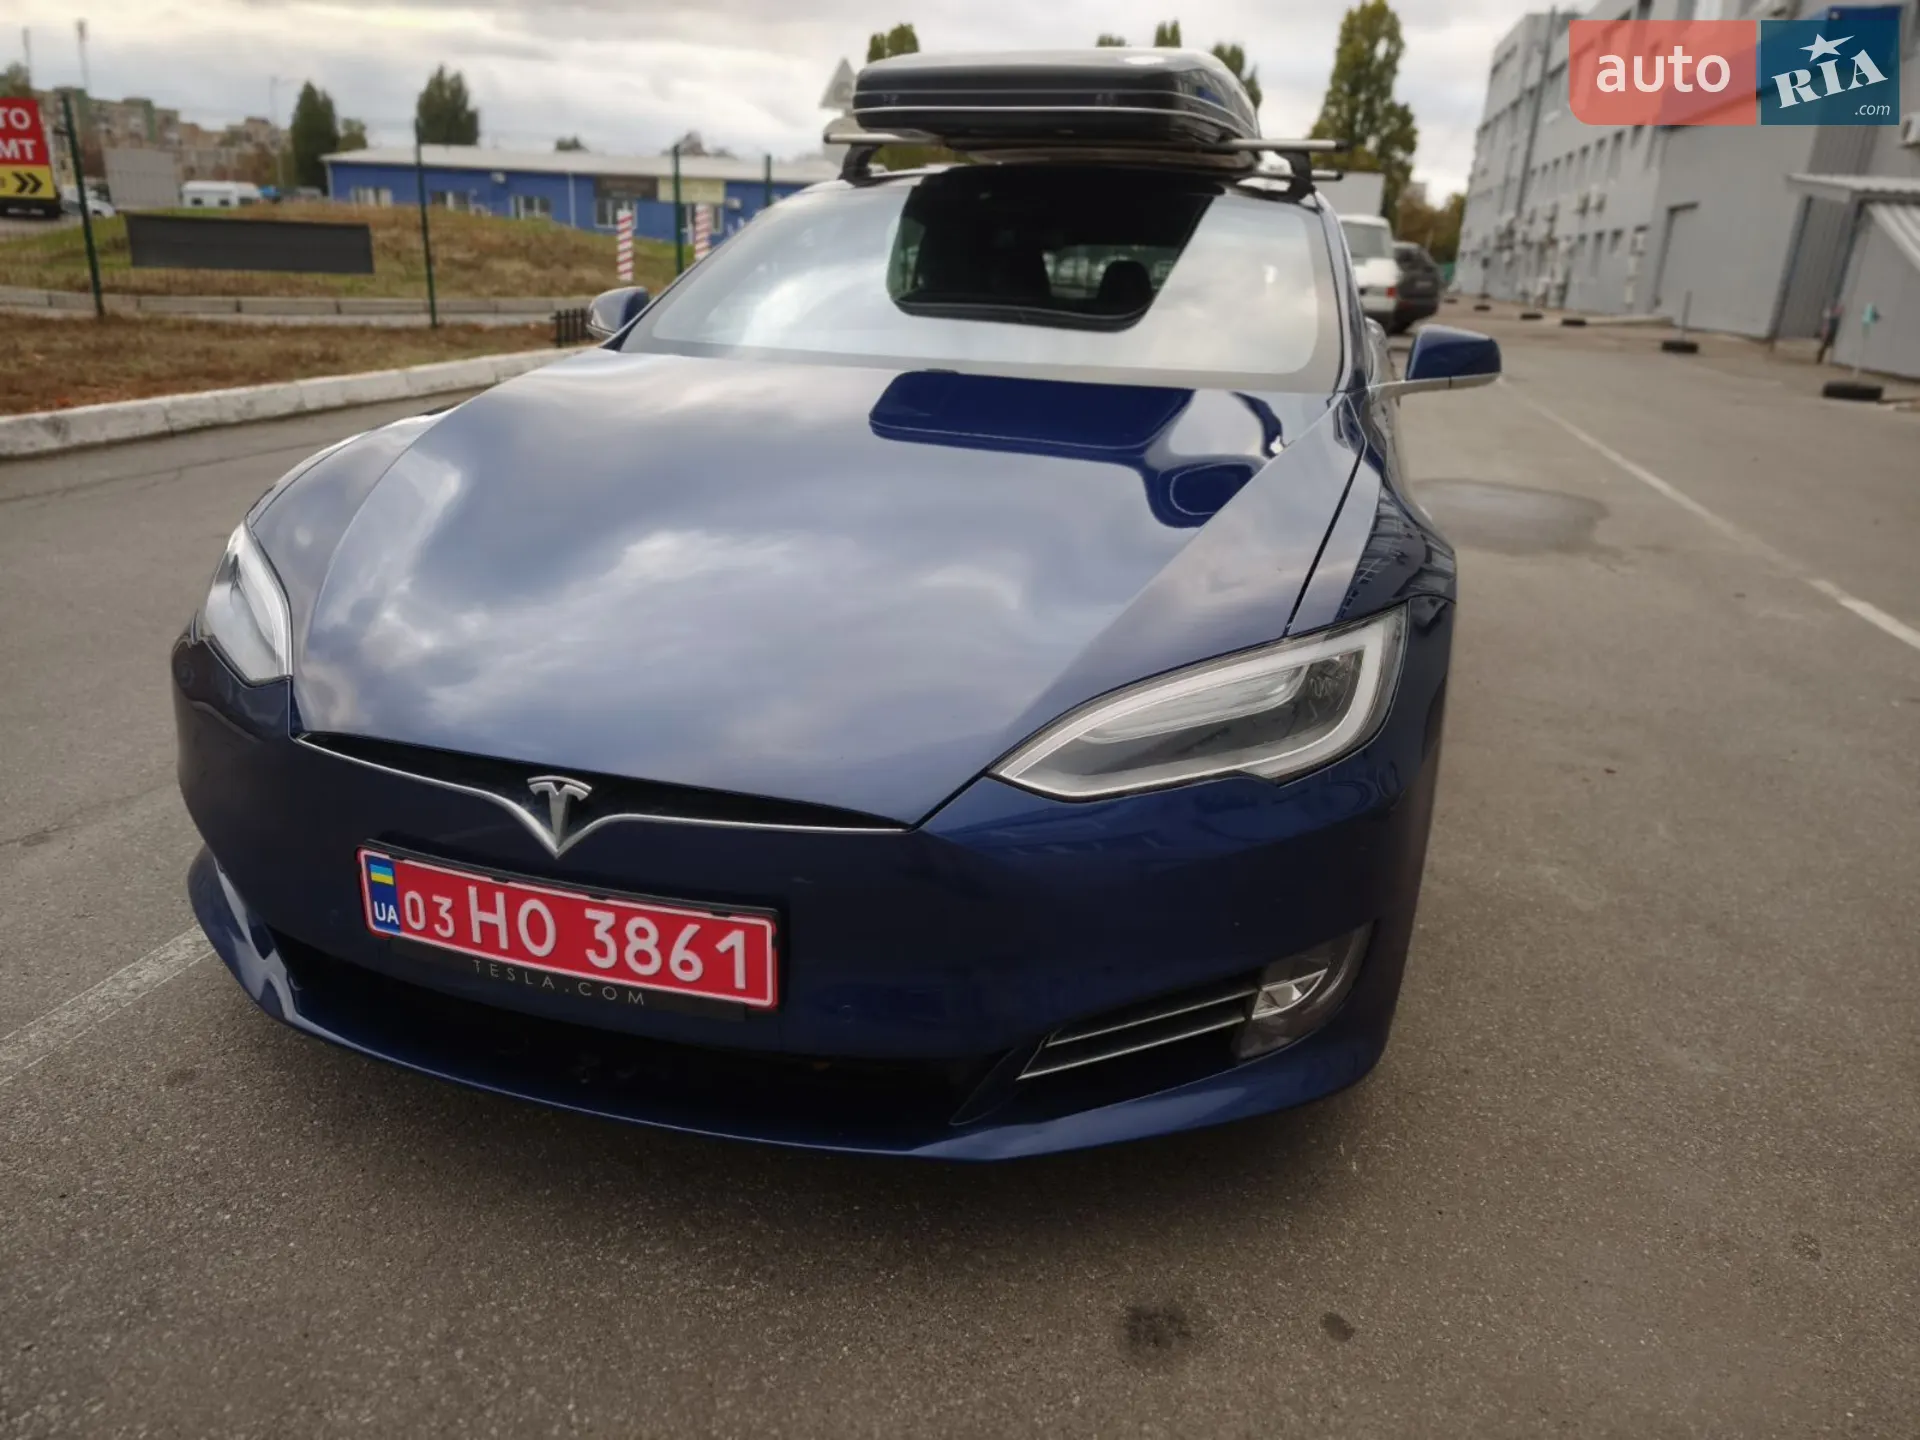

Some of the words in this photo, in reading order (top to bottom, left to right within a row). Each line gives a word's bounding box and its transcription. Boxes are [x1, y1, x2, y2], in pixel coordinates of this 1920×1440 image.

[374, 901, 400, 925] UA
[404, 890, 455, 938] 03
[584, 908, 746, 990] 3861
[472, 959, 644, 1005] TESLA.COM
